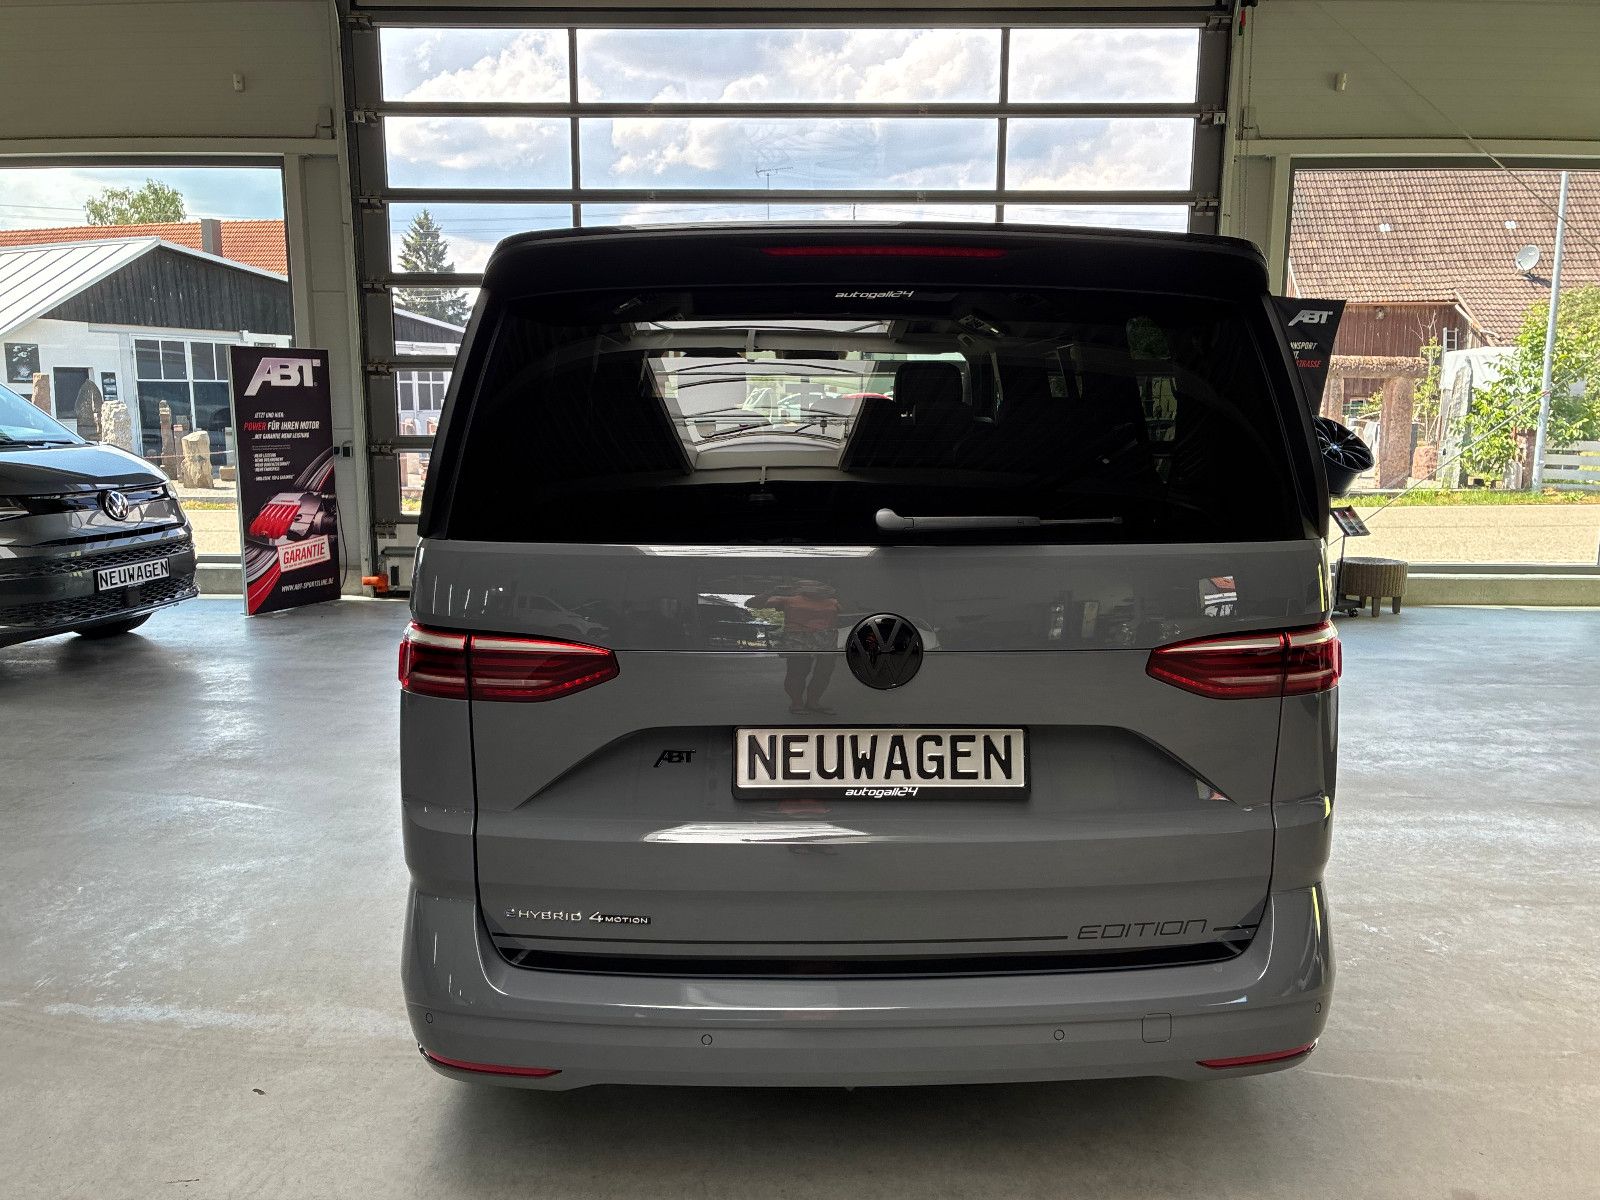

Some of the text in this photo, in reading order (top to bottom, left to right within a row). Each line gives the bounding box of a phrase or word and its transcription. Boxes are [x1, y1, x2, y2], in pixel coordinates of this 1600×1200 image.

[835, 290, 915, 300] autogall24
[1288, 310, 1333, 326] ABT
[244, 357, 320, 396] ABT
[243, 420, 320, 431] POWER FÜR IHREN MOTOR
[283, 541, 326, 565] GARANTIE
[99, 561, 169, 588] NEUWAGEN
[653, 749, 696, 768] ABT
[747, 734, 1013, 780] NEUWAGEN
[845, 786, 919, 799] autogall24
[1077, 918, 1208, 940] EDITION
